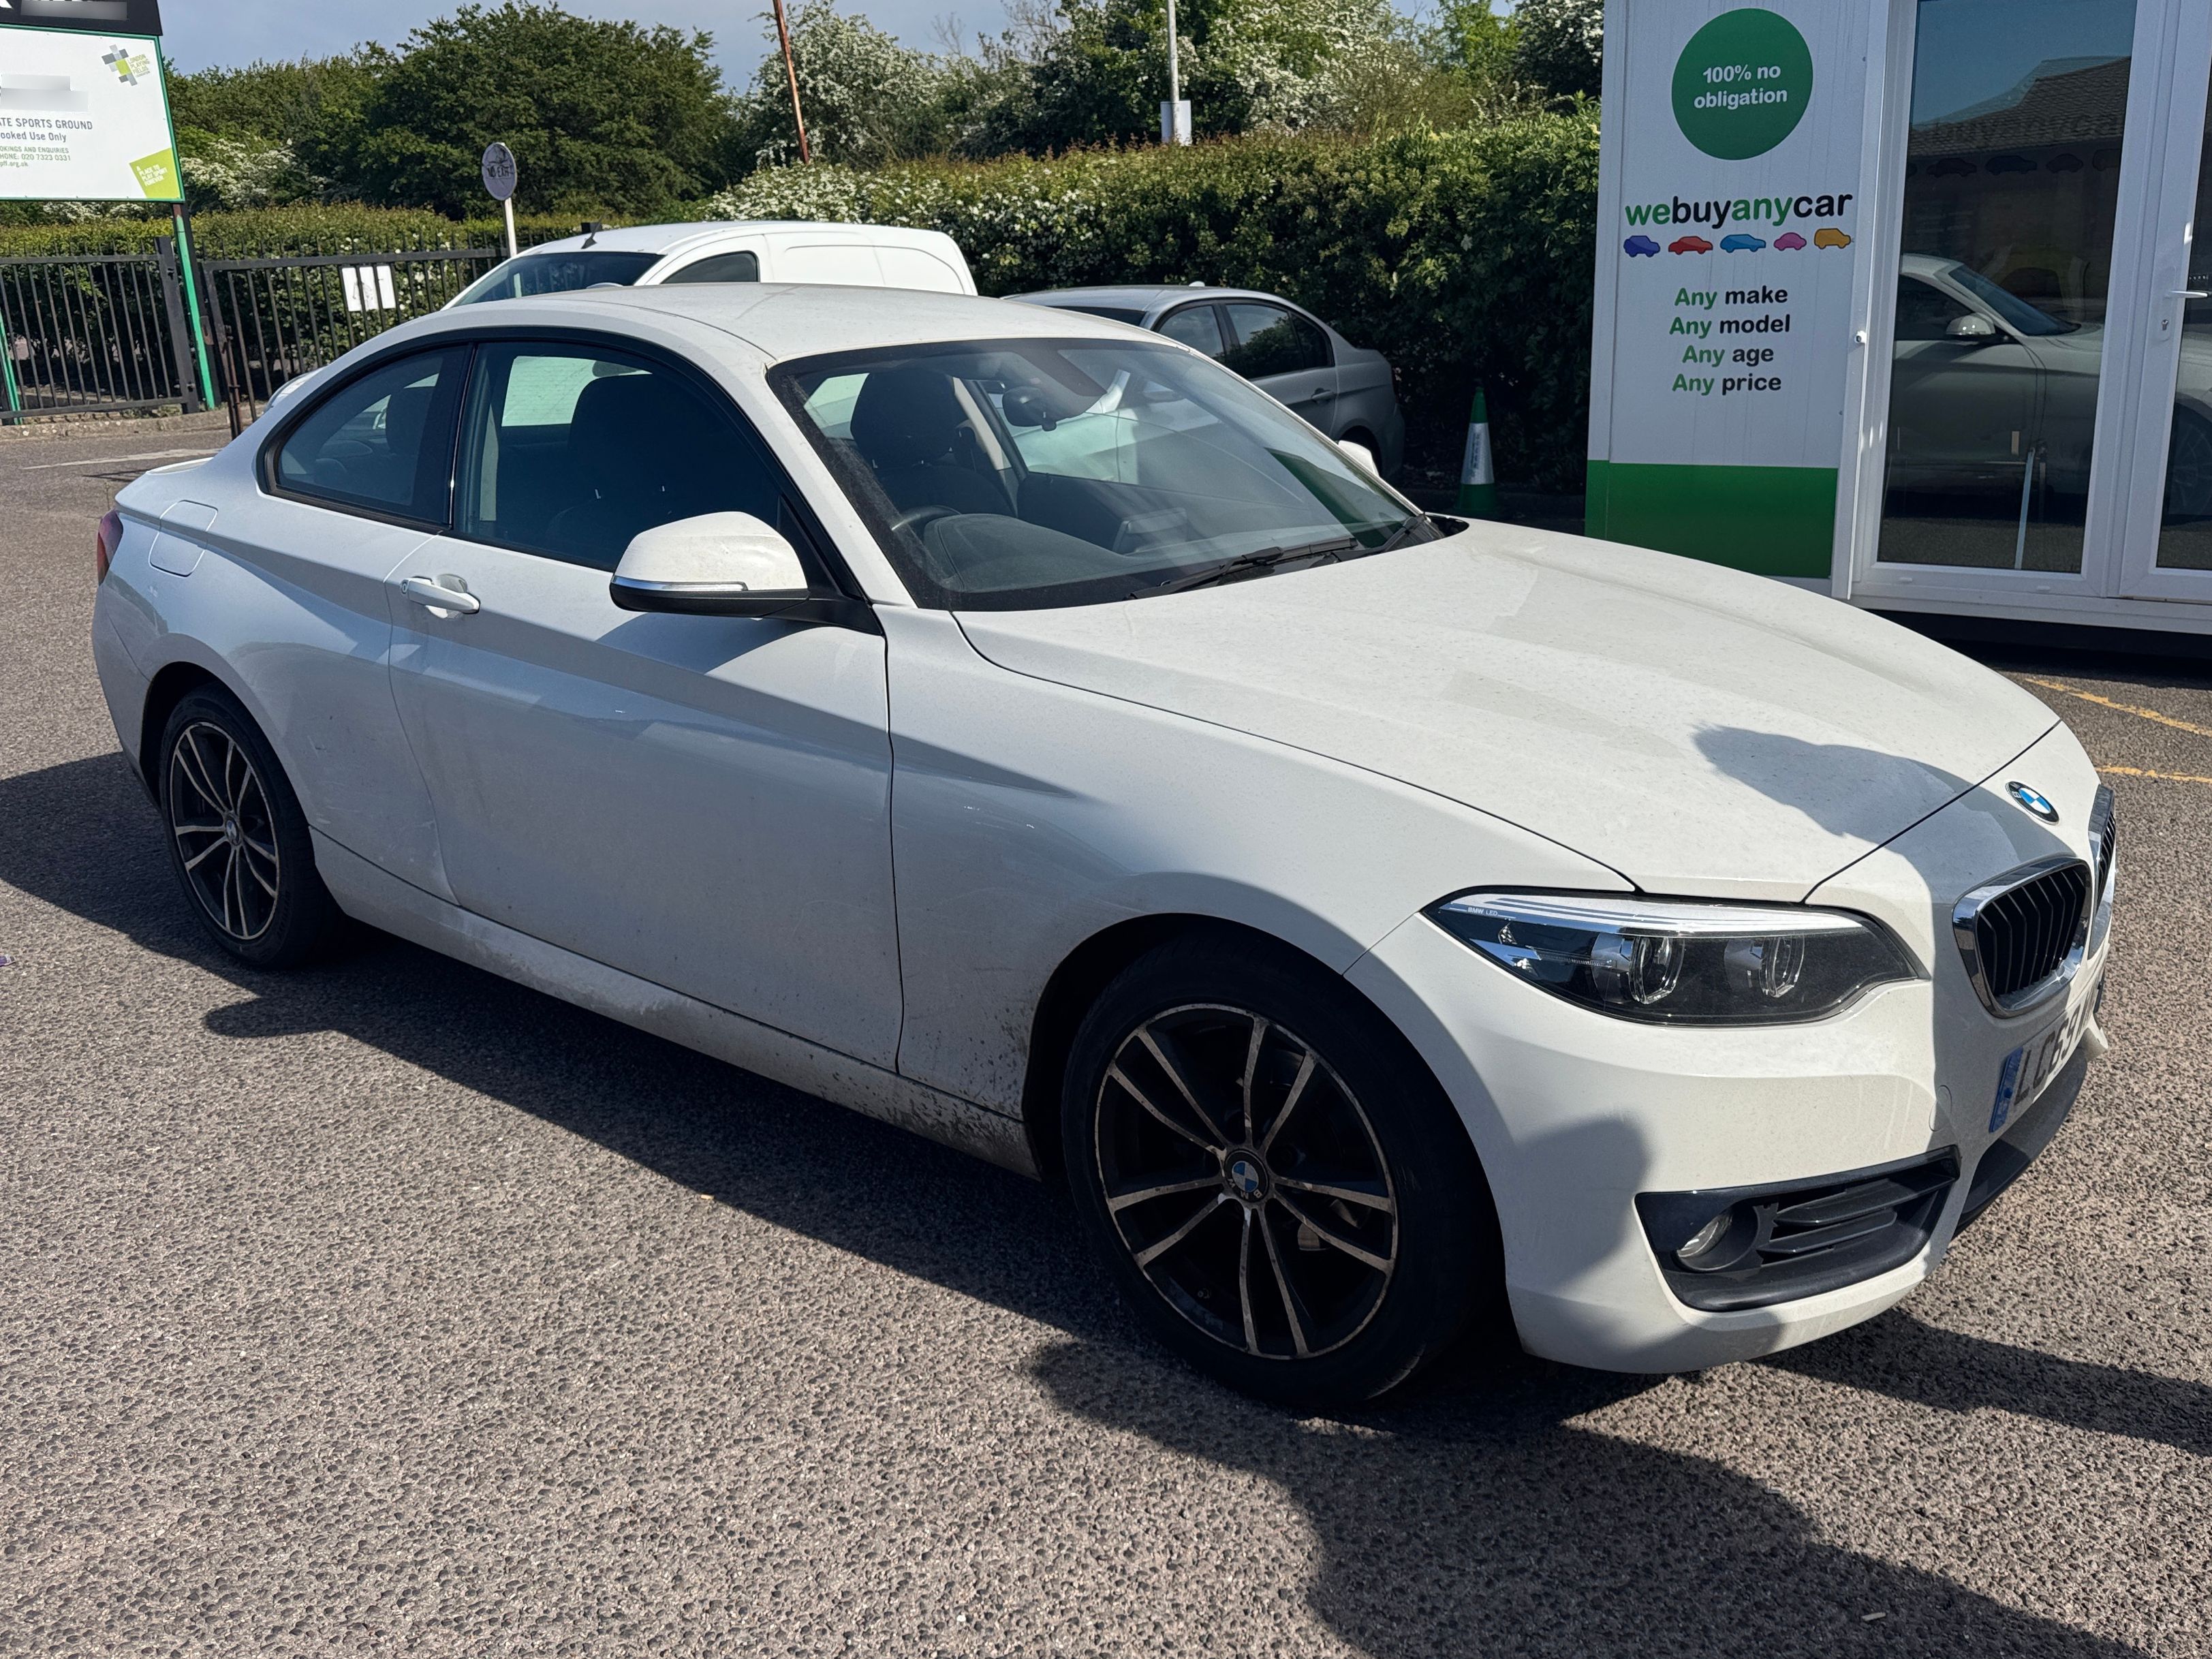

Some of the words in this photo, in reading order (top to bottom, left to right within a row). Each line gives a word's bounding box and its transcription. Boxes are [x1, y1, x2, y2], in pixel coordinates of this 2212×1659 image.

[1702, 64, 1751, 83] 100%
[1757, 66, 1781, 80] no
[1694, 88, 1787, 110] obligation
[16, 119, 52, 128] SPORTS
[55, 120, 93, 129] GROUND
[29, 132, 46, 140] Use
[48, 133, 66, 142] Only
[1625, 194, 1853, 229] webuyanycar
[1674, 288, 1717, 310] Any
[1725, 285, 1788, 305] make
[1669, 317, 1712, 339] Any
[1719, 314, 1790, 334] model
[1682, 345, 1725, 367] Any
[1732, 348, 1774, 367] age
[1672, 374, 1715, 396] Any
[1722, 373, 1781, 395] price
